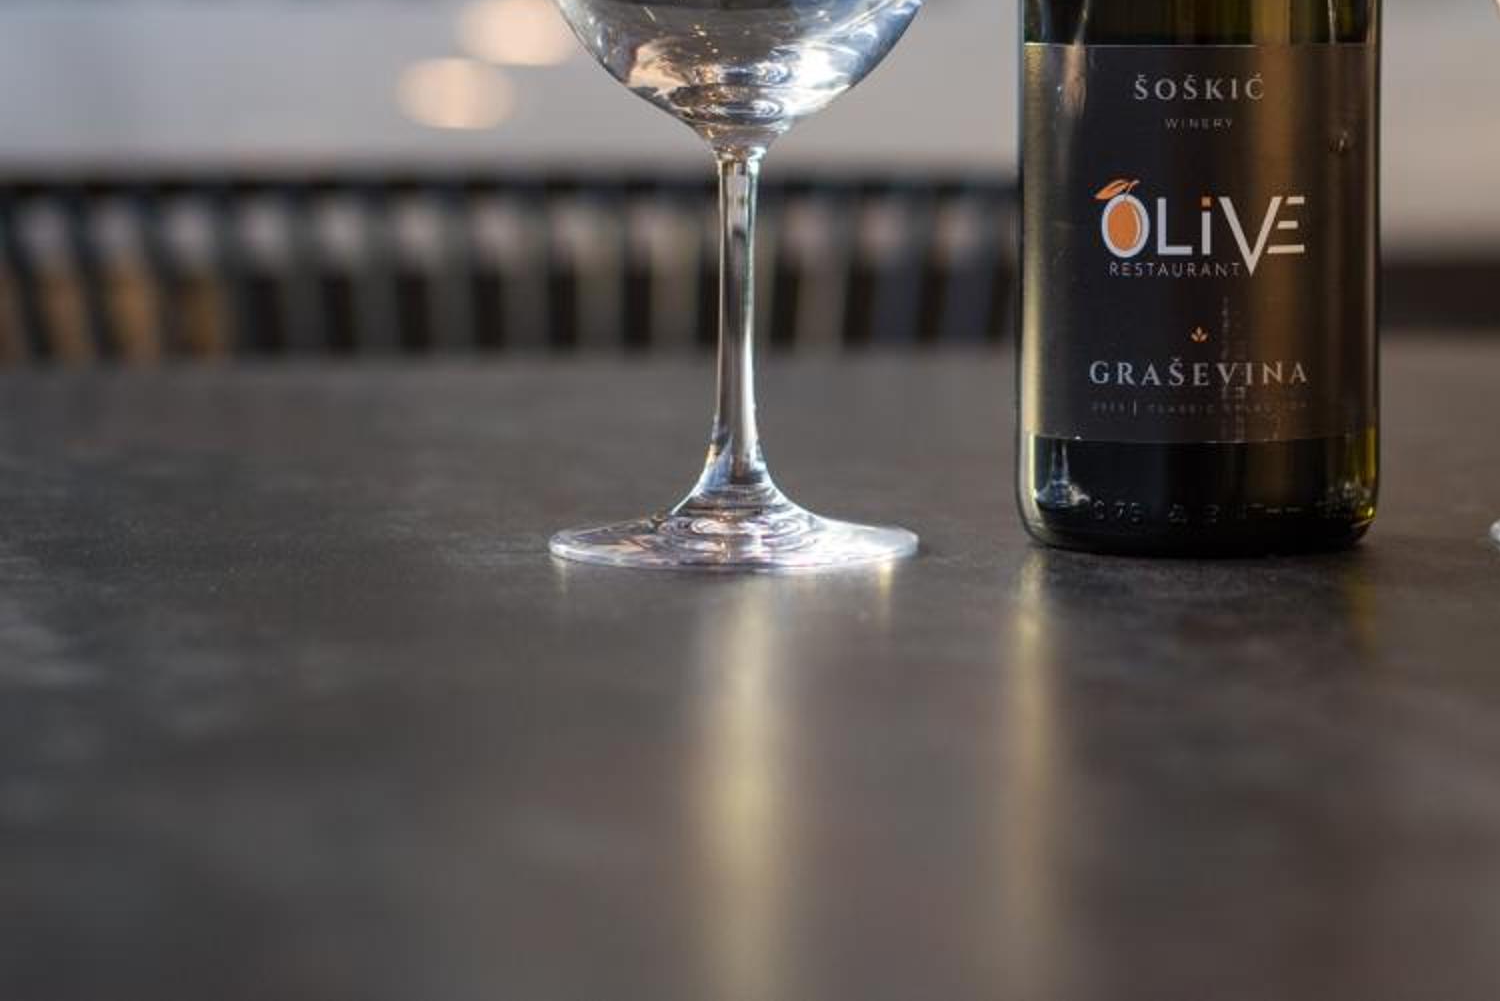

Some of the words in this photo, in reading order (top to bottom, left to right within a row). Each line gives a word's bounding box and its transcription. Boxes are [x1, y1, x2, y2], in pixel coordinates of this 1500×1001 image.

[1134, 73, 1265, 100] ŠOŠKIĆ
[1165, 118, 1233, 129] WINERY
[1109, 262, 1241, 277] RESTAURANT
[1089, 357, 1308, 386] GRAŠEVINA
